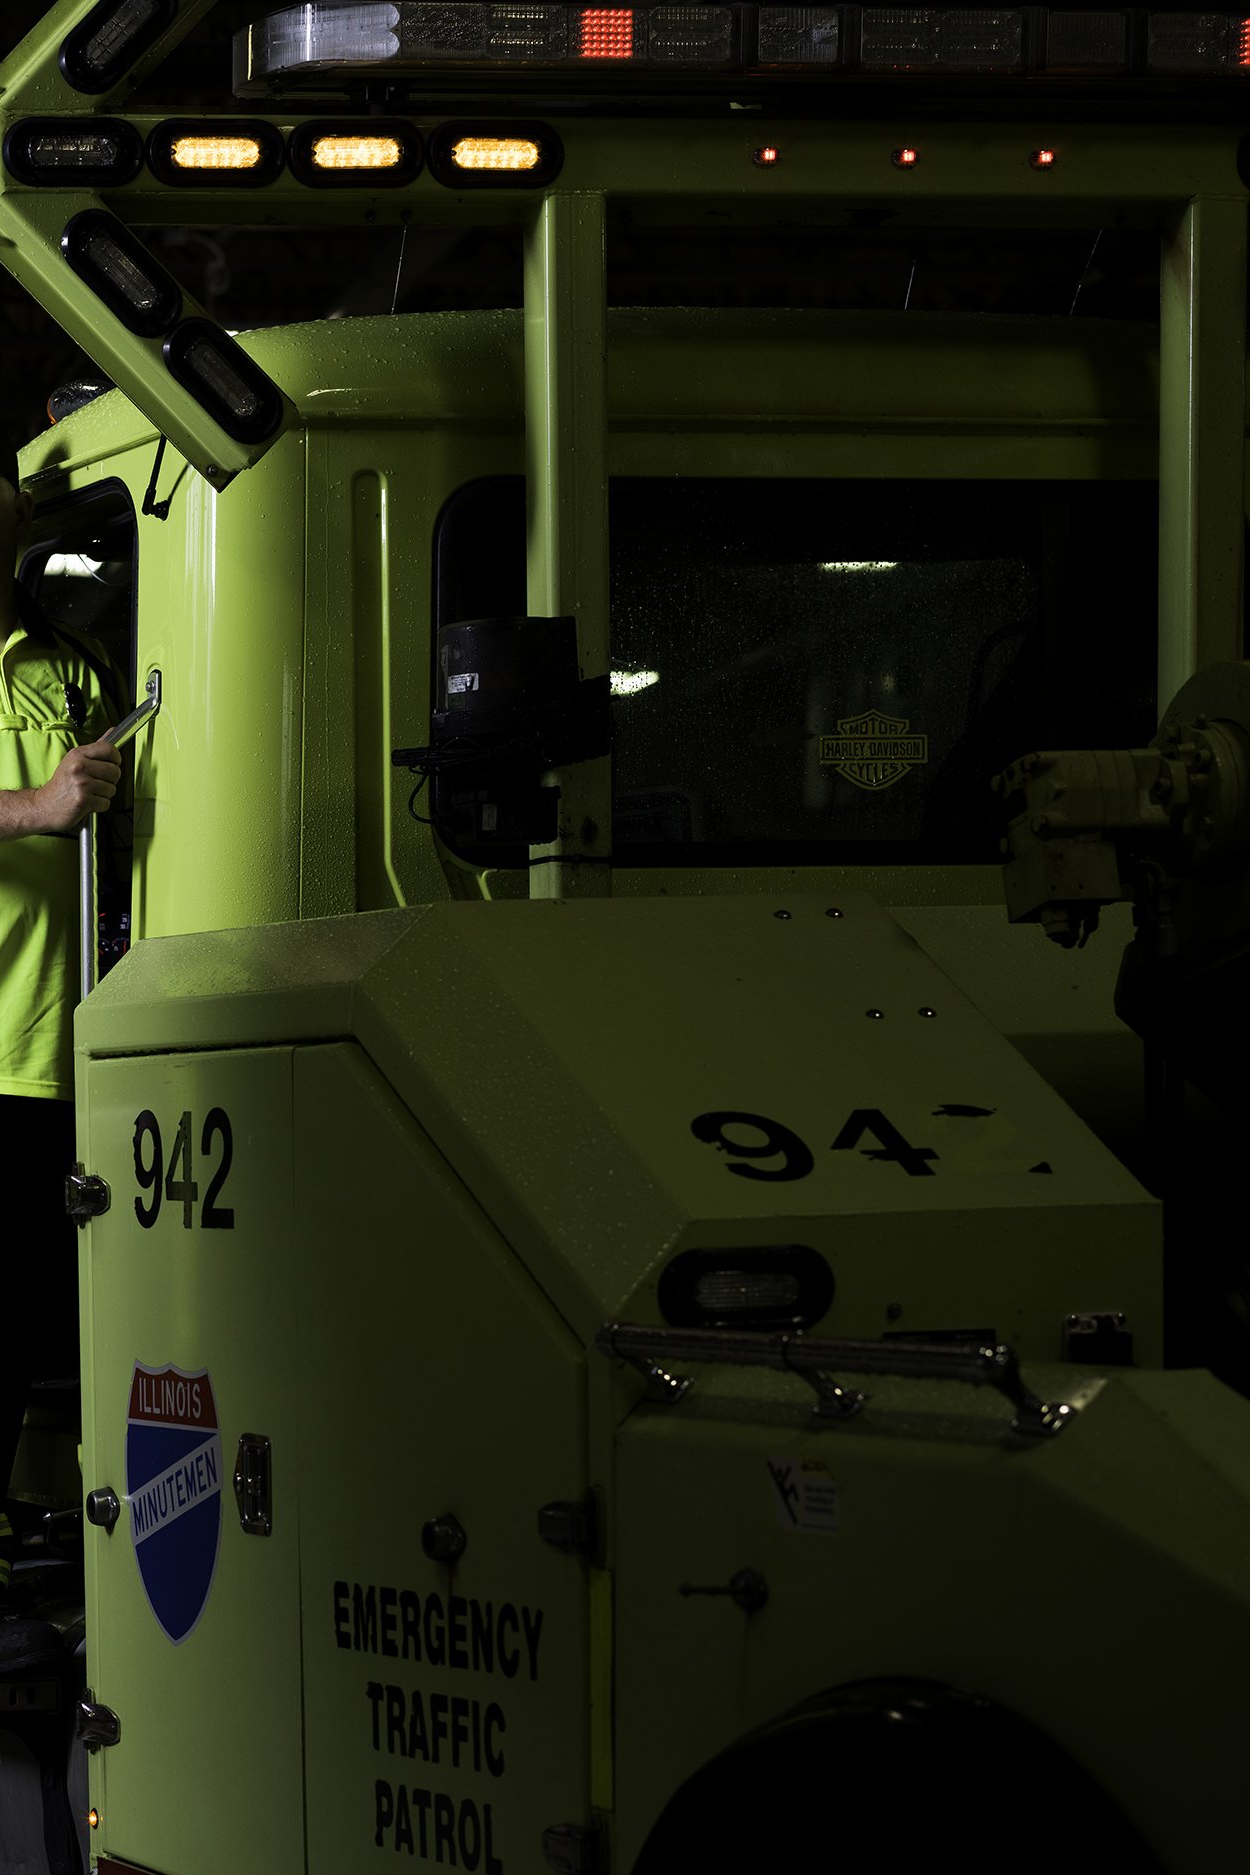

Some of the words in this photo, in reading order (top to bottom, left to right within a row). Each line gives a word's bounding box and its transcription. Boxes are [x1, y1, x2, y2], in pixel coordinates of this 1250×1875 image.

[849, 718, 898, 735] MOTOR
[133, 1106, 235, 1230] 942
[690, 1104, 1053, 1182] 94
[138, 1376, 202, 1420] ILLINOIS
[131, 1446, 218, 1537] MINUTEMEN
[333, 1580, 544, 1681] EMERGENCY
[365, 1681, 507, 1777] TRAFFIC
[374, 1779, 503, 1875] PATROL
